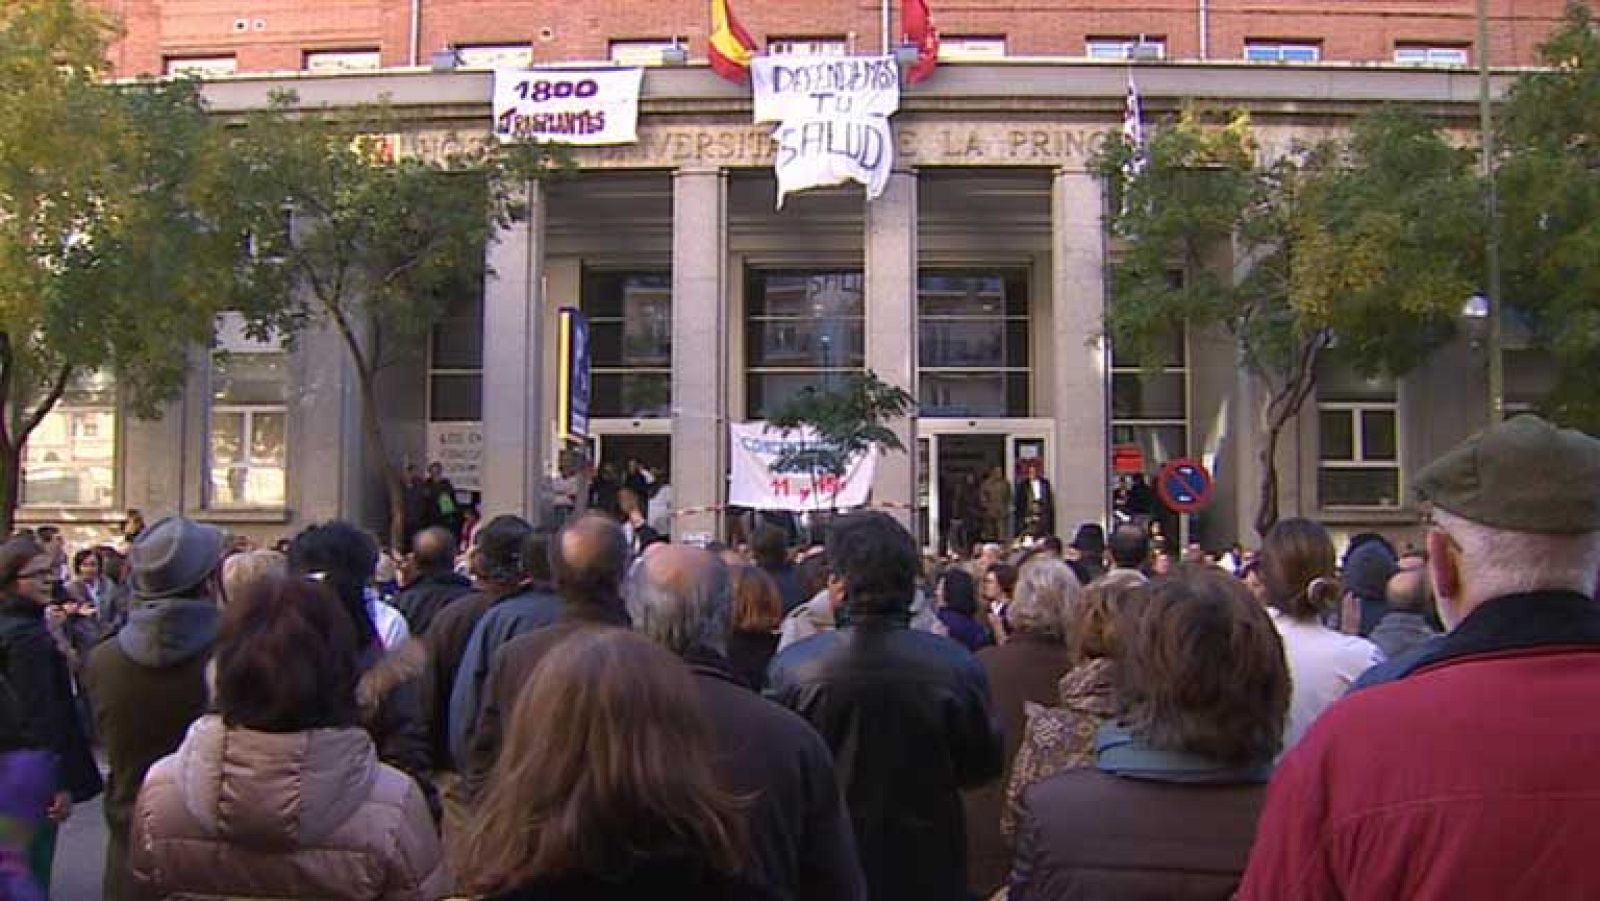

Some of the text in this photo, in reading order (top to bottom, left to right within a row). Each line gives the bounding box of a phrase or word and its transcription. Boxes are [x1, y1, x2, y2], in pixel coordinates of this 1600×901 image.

[514, 79, 599, 101] 1800
[811, 94, 852, 114] TU
[778, 119, 884, 172] SALUD
[944, 131, 985, 157] LA
